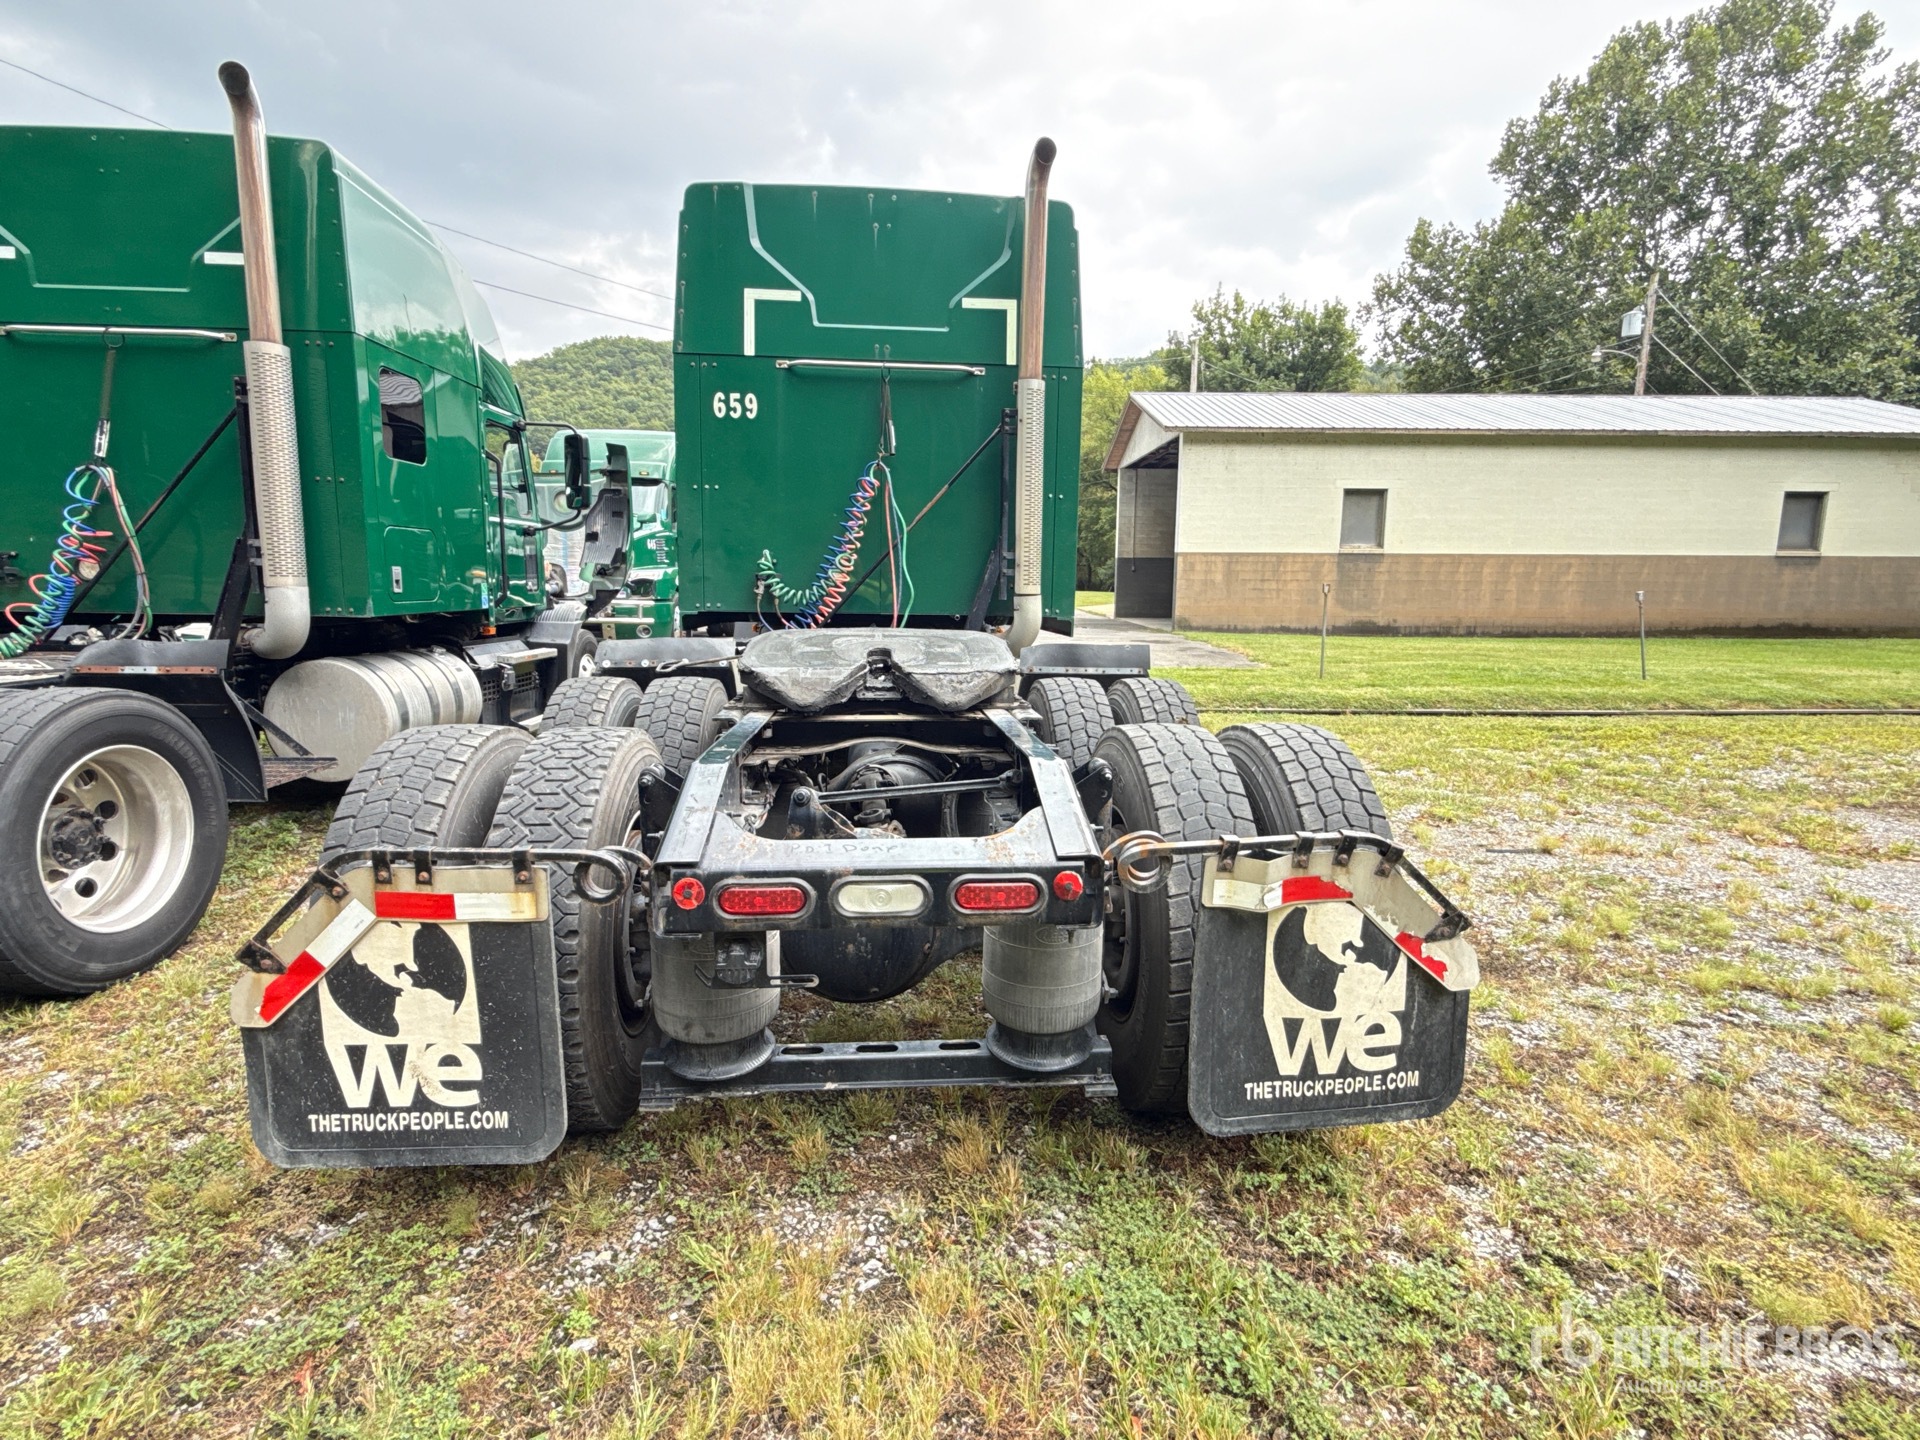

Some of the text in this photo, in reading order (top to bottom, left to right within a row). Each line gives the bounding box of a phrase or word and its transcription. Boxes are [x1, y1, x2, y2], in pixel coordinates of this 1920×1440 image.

[713, 391, 758, 419] 659
[1244, 1070, 1420, 1100] THETRUCKPEOPLE.COM
[308, 1110, 509, 1132] THETRUCKPEOPLE.COM
